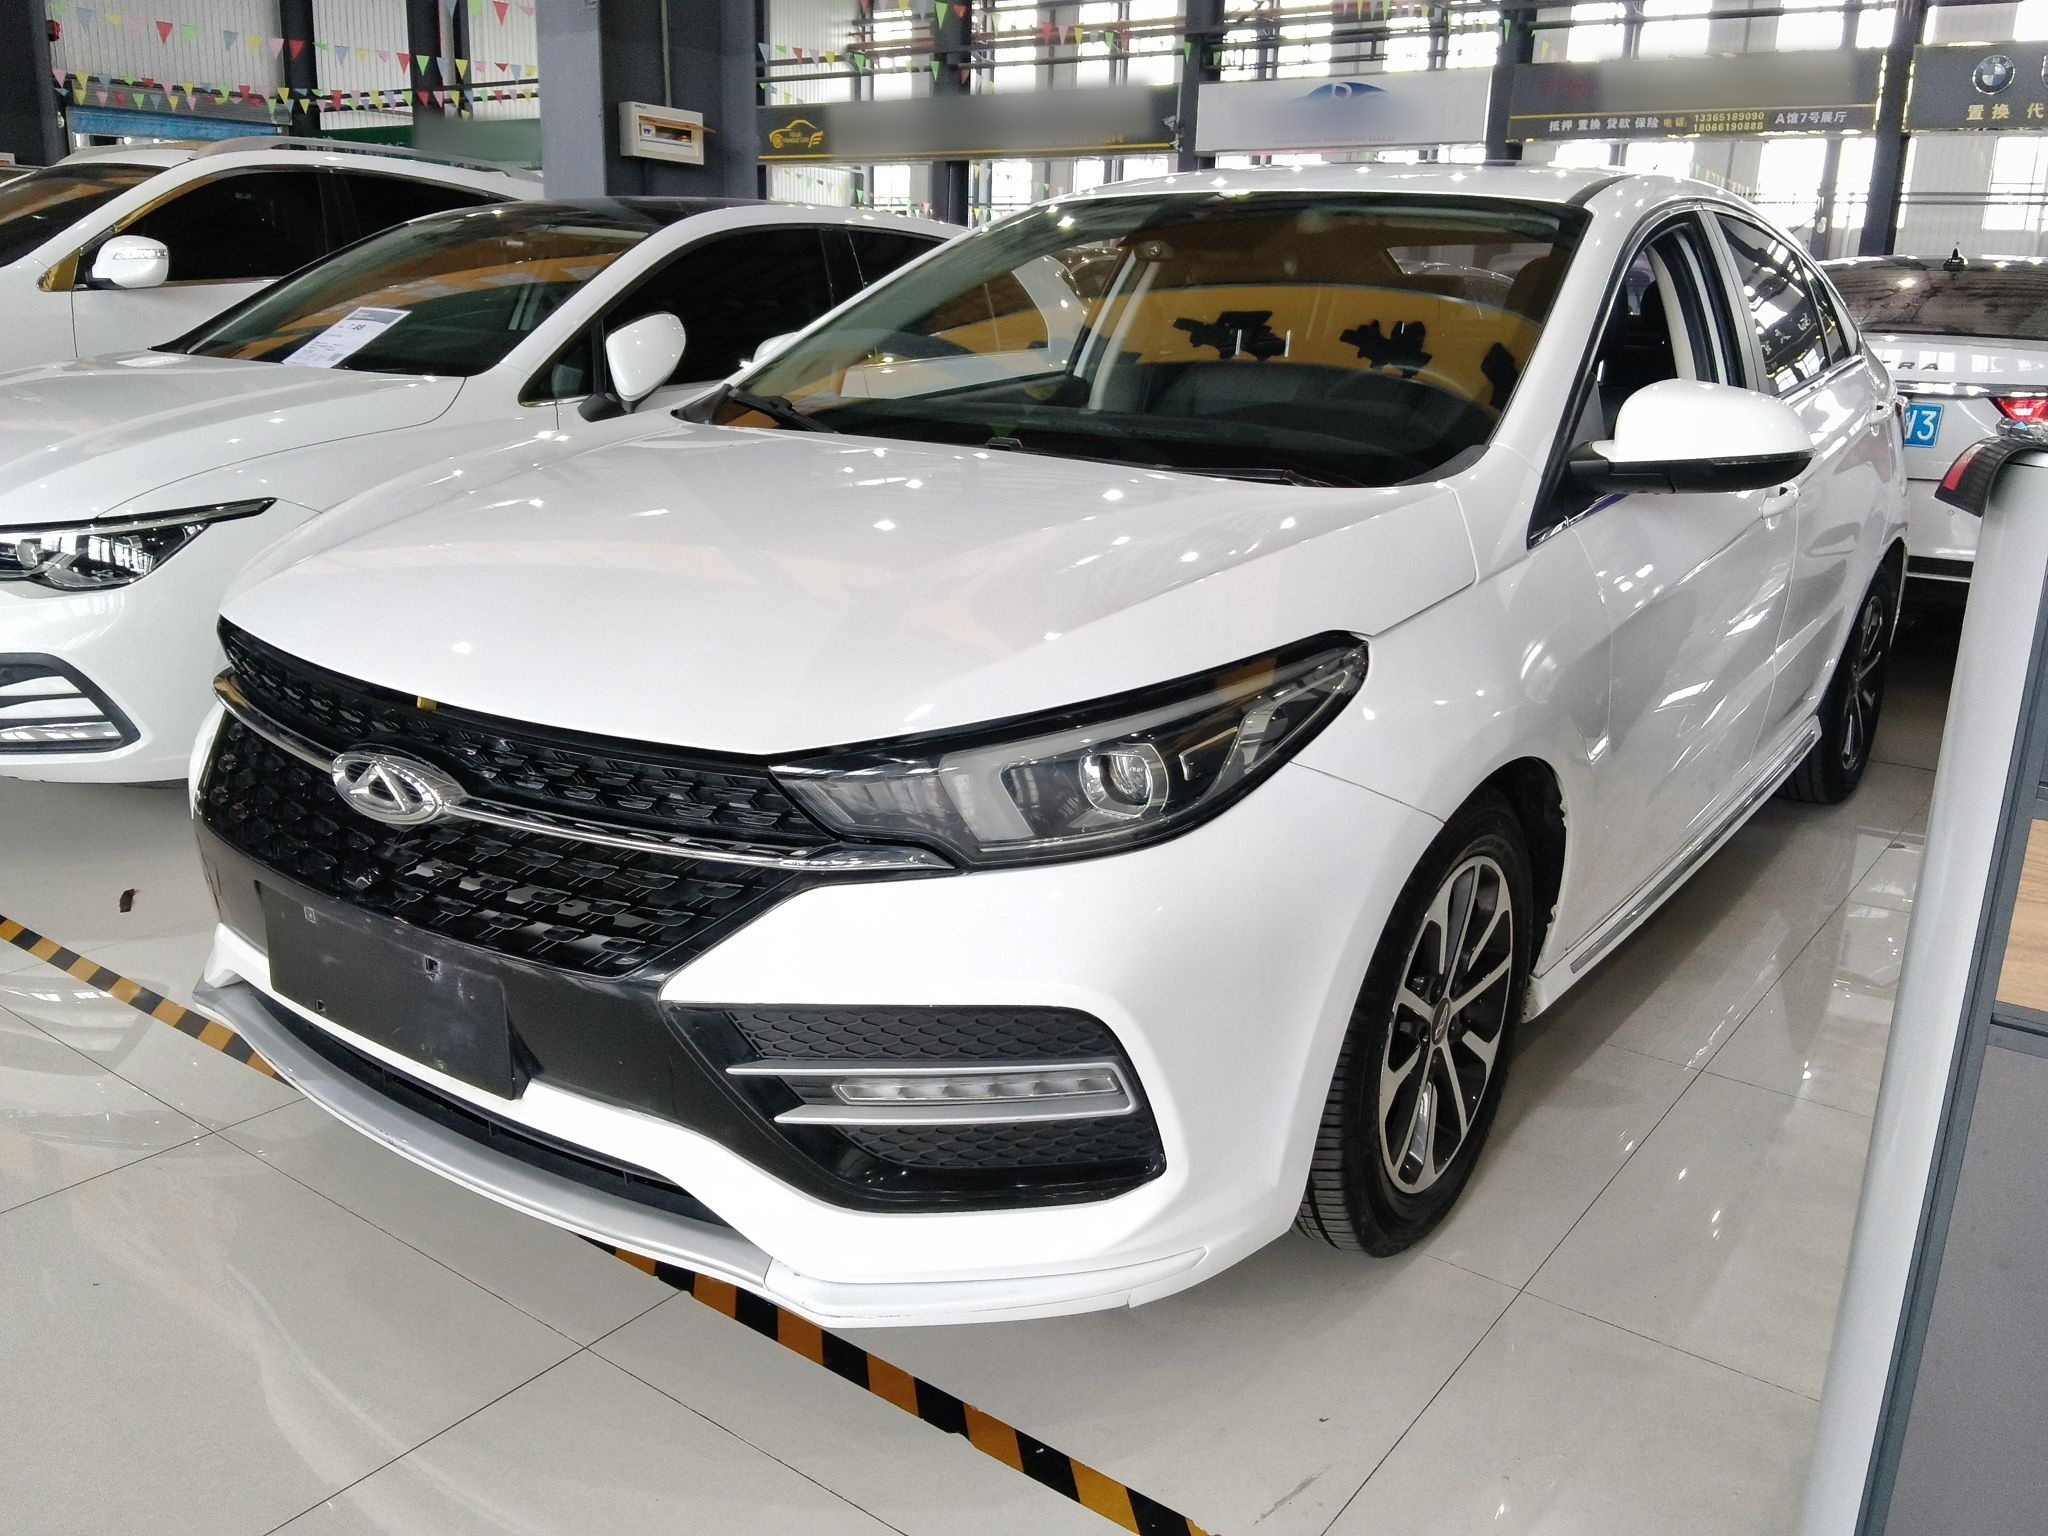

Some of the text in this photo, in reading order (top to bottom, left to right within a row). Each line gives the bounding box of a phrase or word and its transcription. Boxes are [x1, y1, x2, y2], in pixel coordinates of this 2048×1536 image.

[1775, 111, 1848, 125] A馆7号展厅
[1966, 102, 2045, 121] 置换 代
[1549, 120, 1573, 132] 抵押
[1635, 116, 1659, 129] 保险
